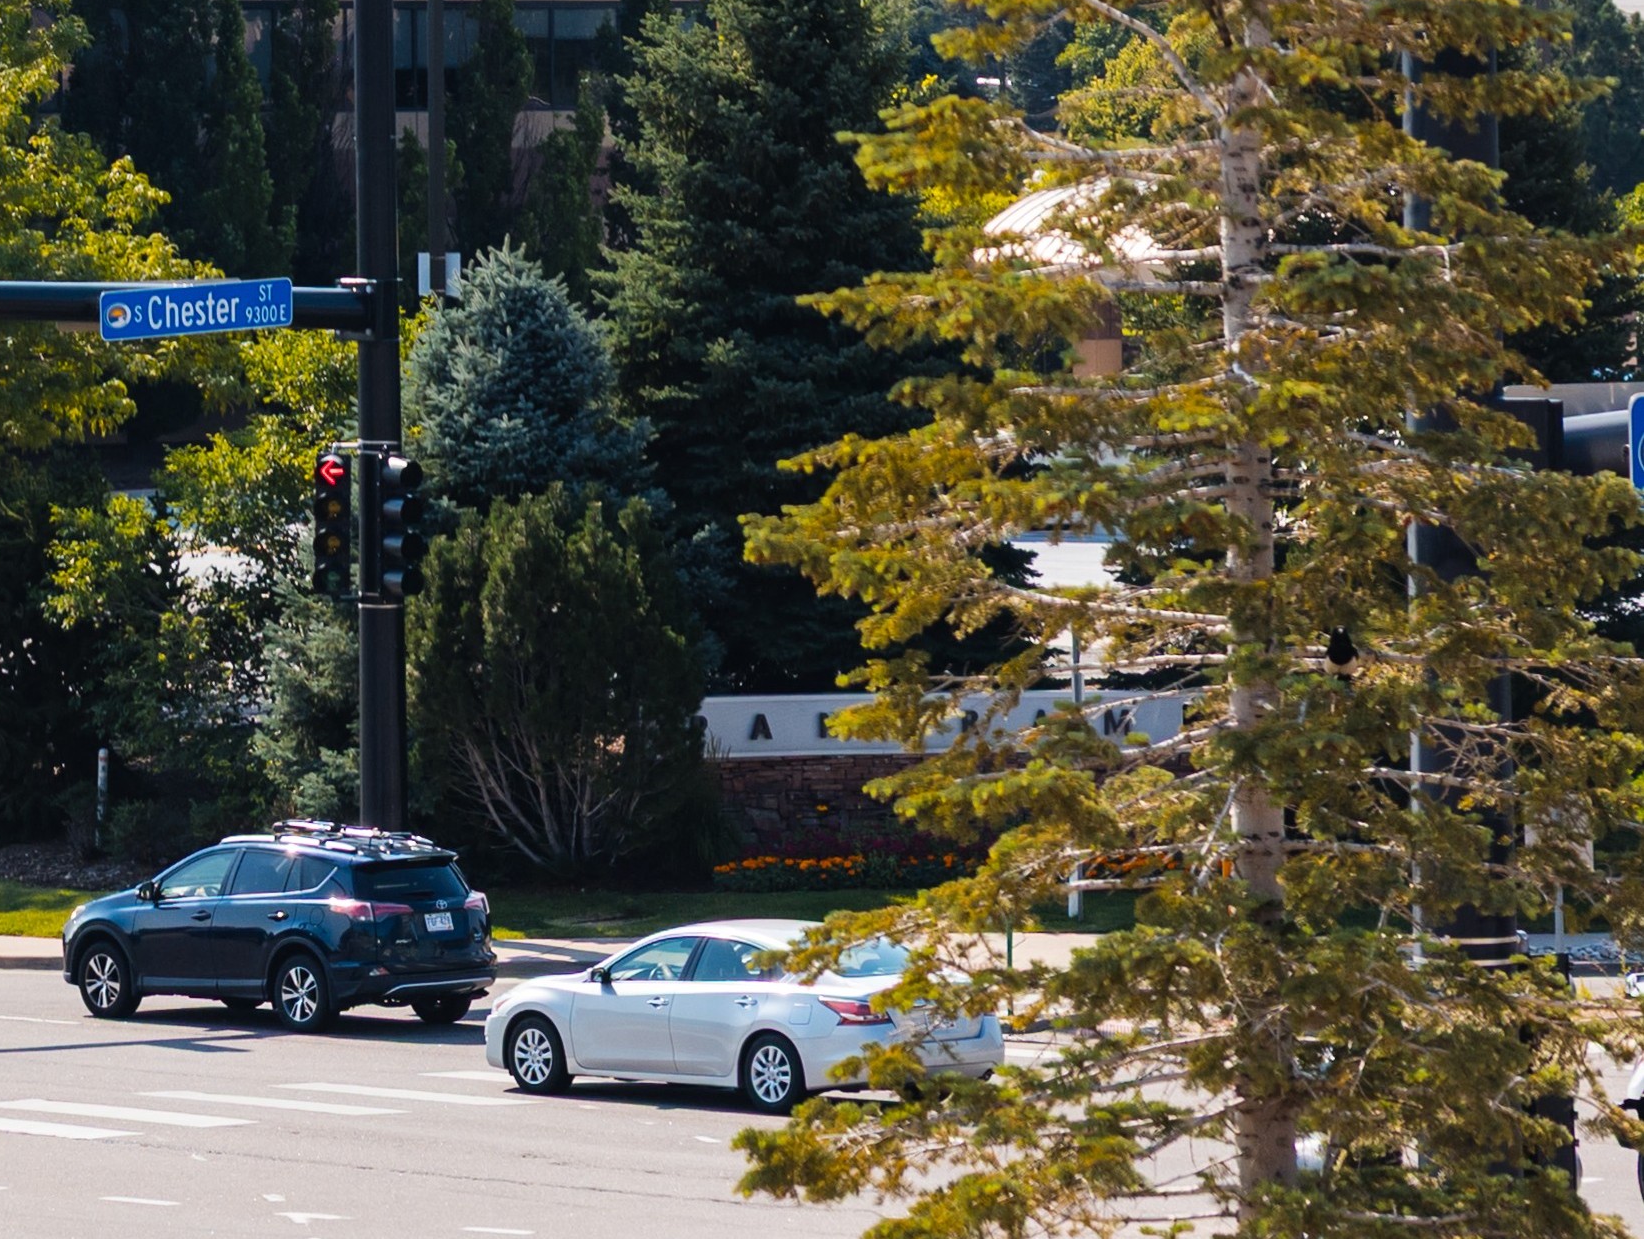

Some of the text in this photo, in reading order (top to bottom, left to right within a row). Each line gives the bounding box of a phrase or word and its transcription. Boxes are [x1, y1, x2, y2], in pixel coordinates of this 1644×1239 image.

[258, 283, 273, 302] ST
[134, 291, 240, 330] S Chester
[245, 304, 278, 324] 9300
